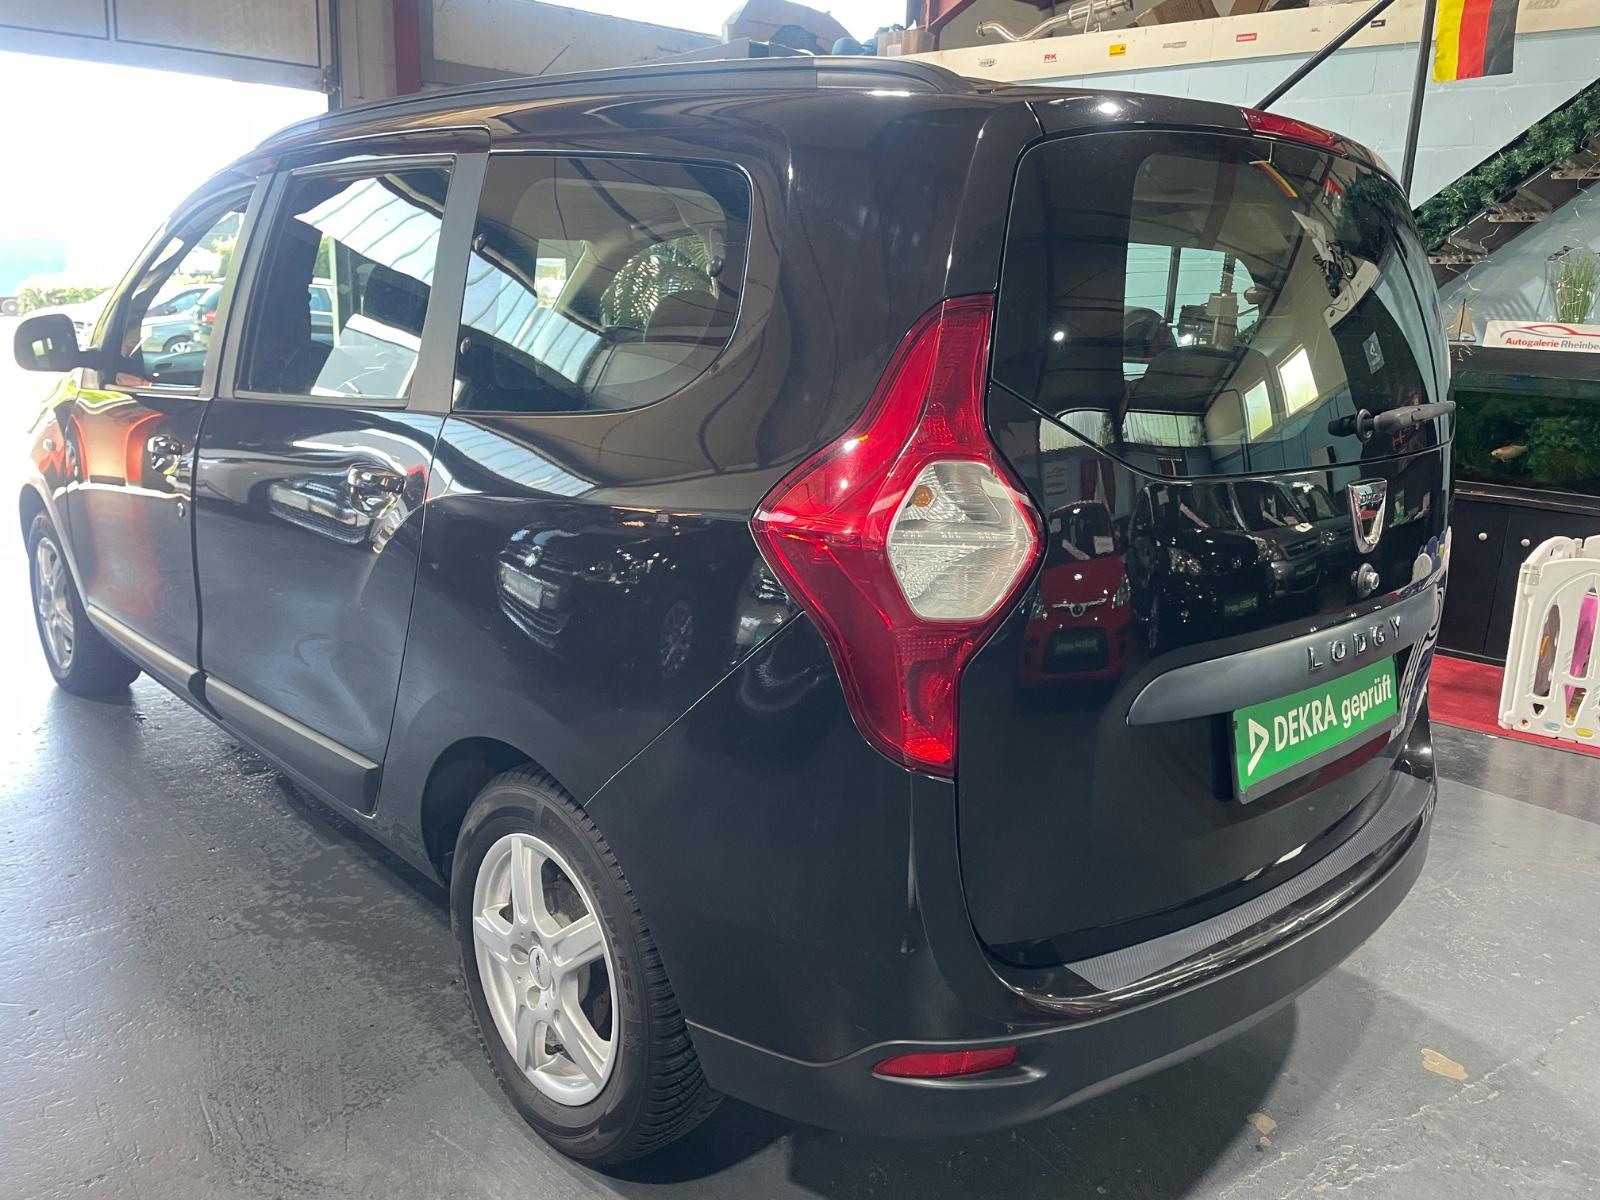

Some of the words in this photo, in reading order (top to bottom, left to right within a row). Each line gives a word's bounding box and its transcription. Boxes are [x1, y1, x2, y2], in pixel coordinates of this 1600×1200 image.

[1505, 337, 1559, 348] Autogalerie
[1561, 340, 1600, 351] Rheinbe
[1307, 615, 1401, 671] LODGY
[1273, 694, 1338, 753] DEKRA
[1341, 673, 1392, 729] geprüft
